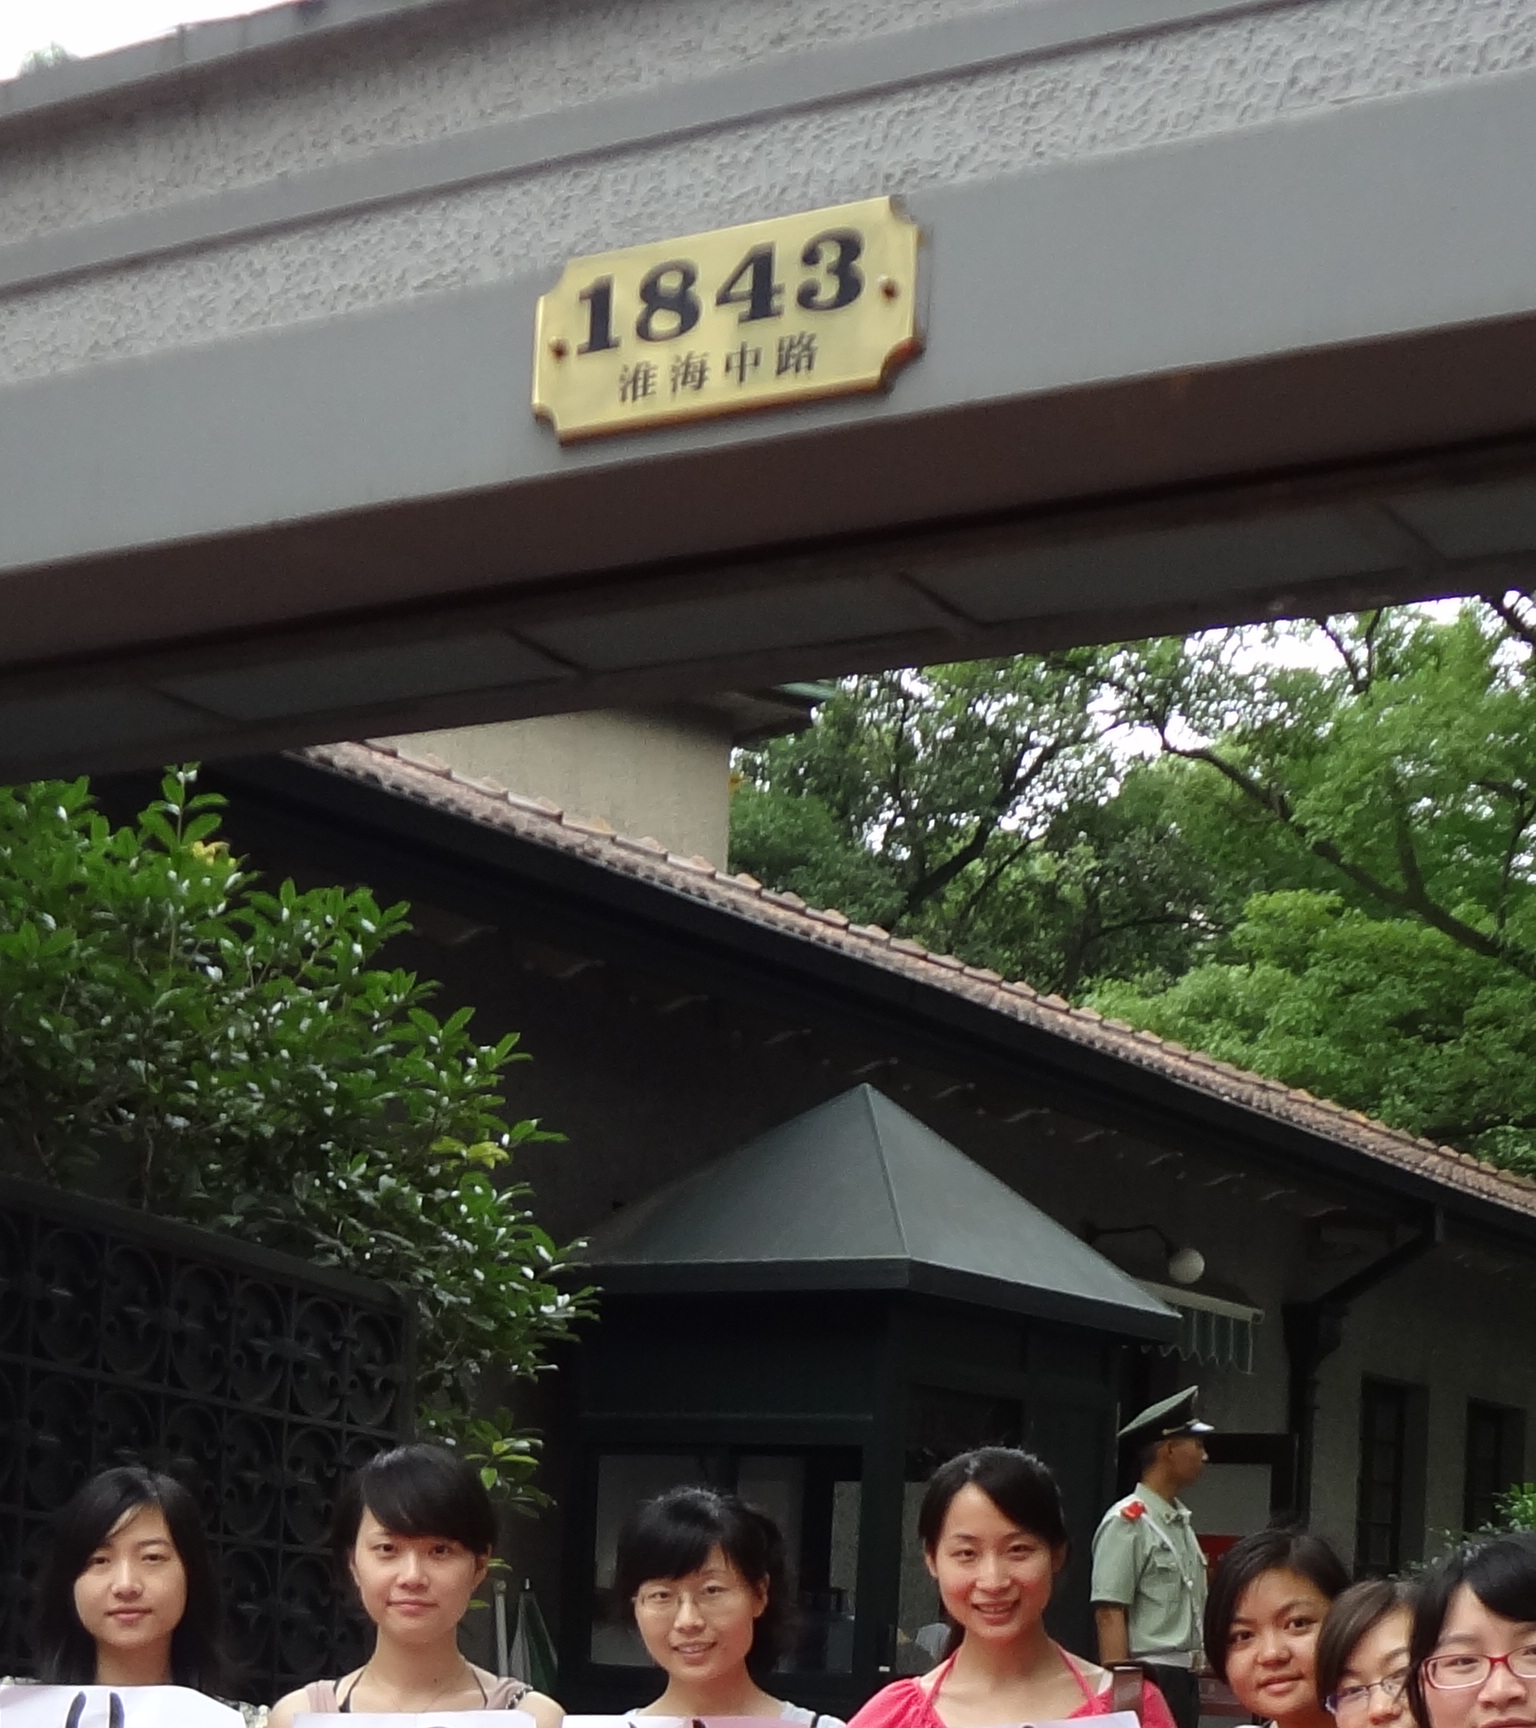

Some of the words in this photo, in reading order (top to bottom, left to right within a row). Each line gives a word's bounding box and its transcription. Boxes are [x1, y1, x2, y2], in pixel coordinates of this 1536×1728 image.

[576, 226, 865, 355] 1843
[619, 331, 819, 403] 淮海中路
